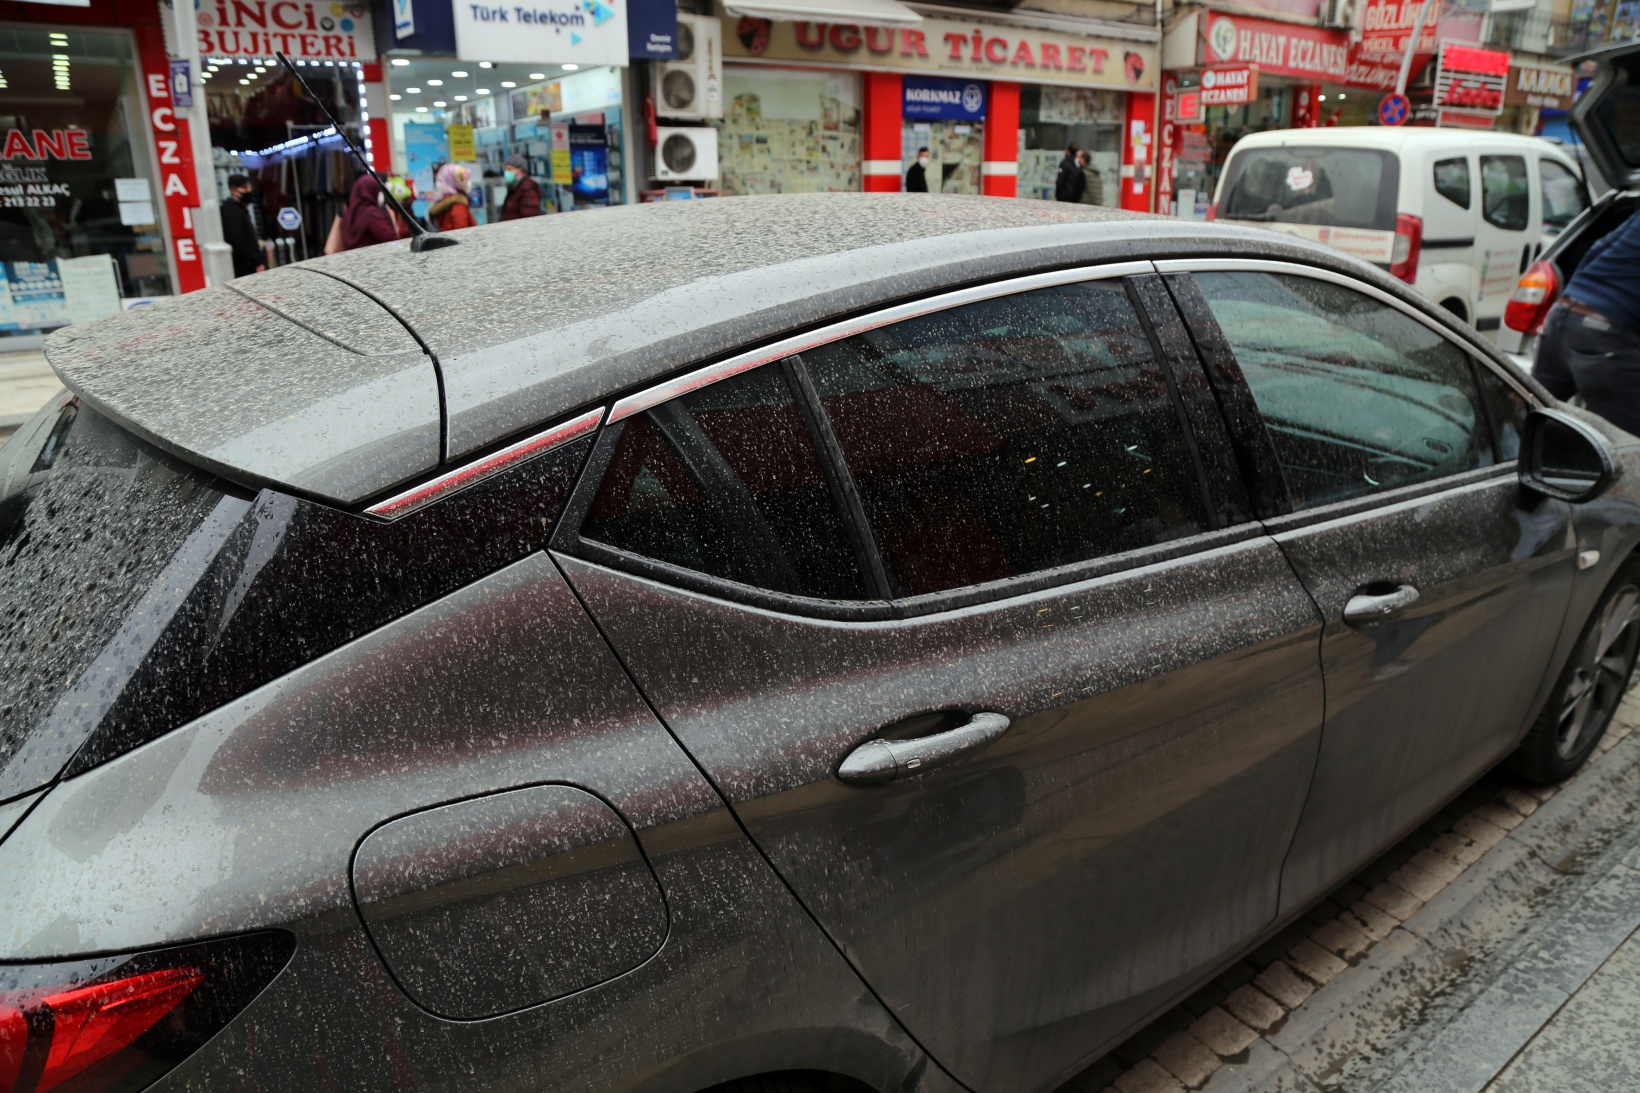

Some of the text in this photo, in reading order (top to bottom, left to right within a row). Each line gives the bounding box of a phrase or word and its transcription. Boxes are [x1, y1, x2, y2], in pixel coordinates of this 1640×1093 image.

[470, 5, 585, 27] Türk Telekom
[1365, 0, 1441, 30] GÖZLÜKÜ
[944, 29, 1109, 74] TİCARET
[1238, 29, 1347, 76] HAYAT ECZANESİ
[1214, 70, 1249, 87] HAYAT
[906, 88, 962, 104] KORKMAZ
[1181, 93, 1198, 118] E
[1201, 86, 1248, 105] ECZANESİ
[0, 129, 92, 161] ANE
